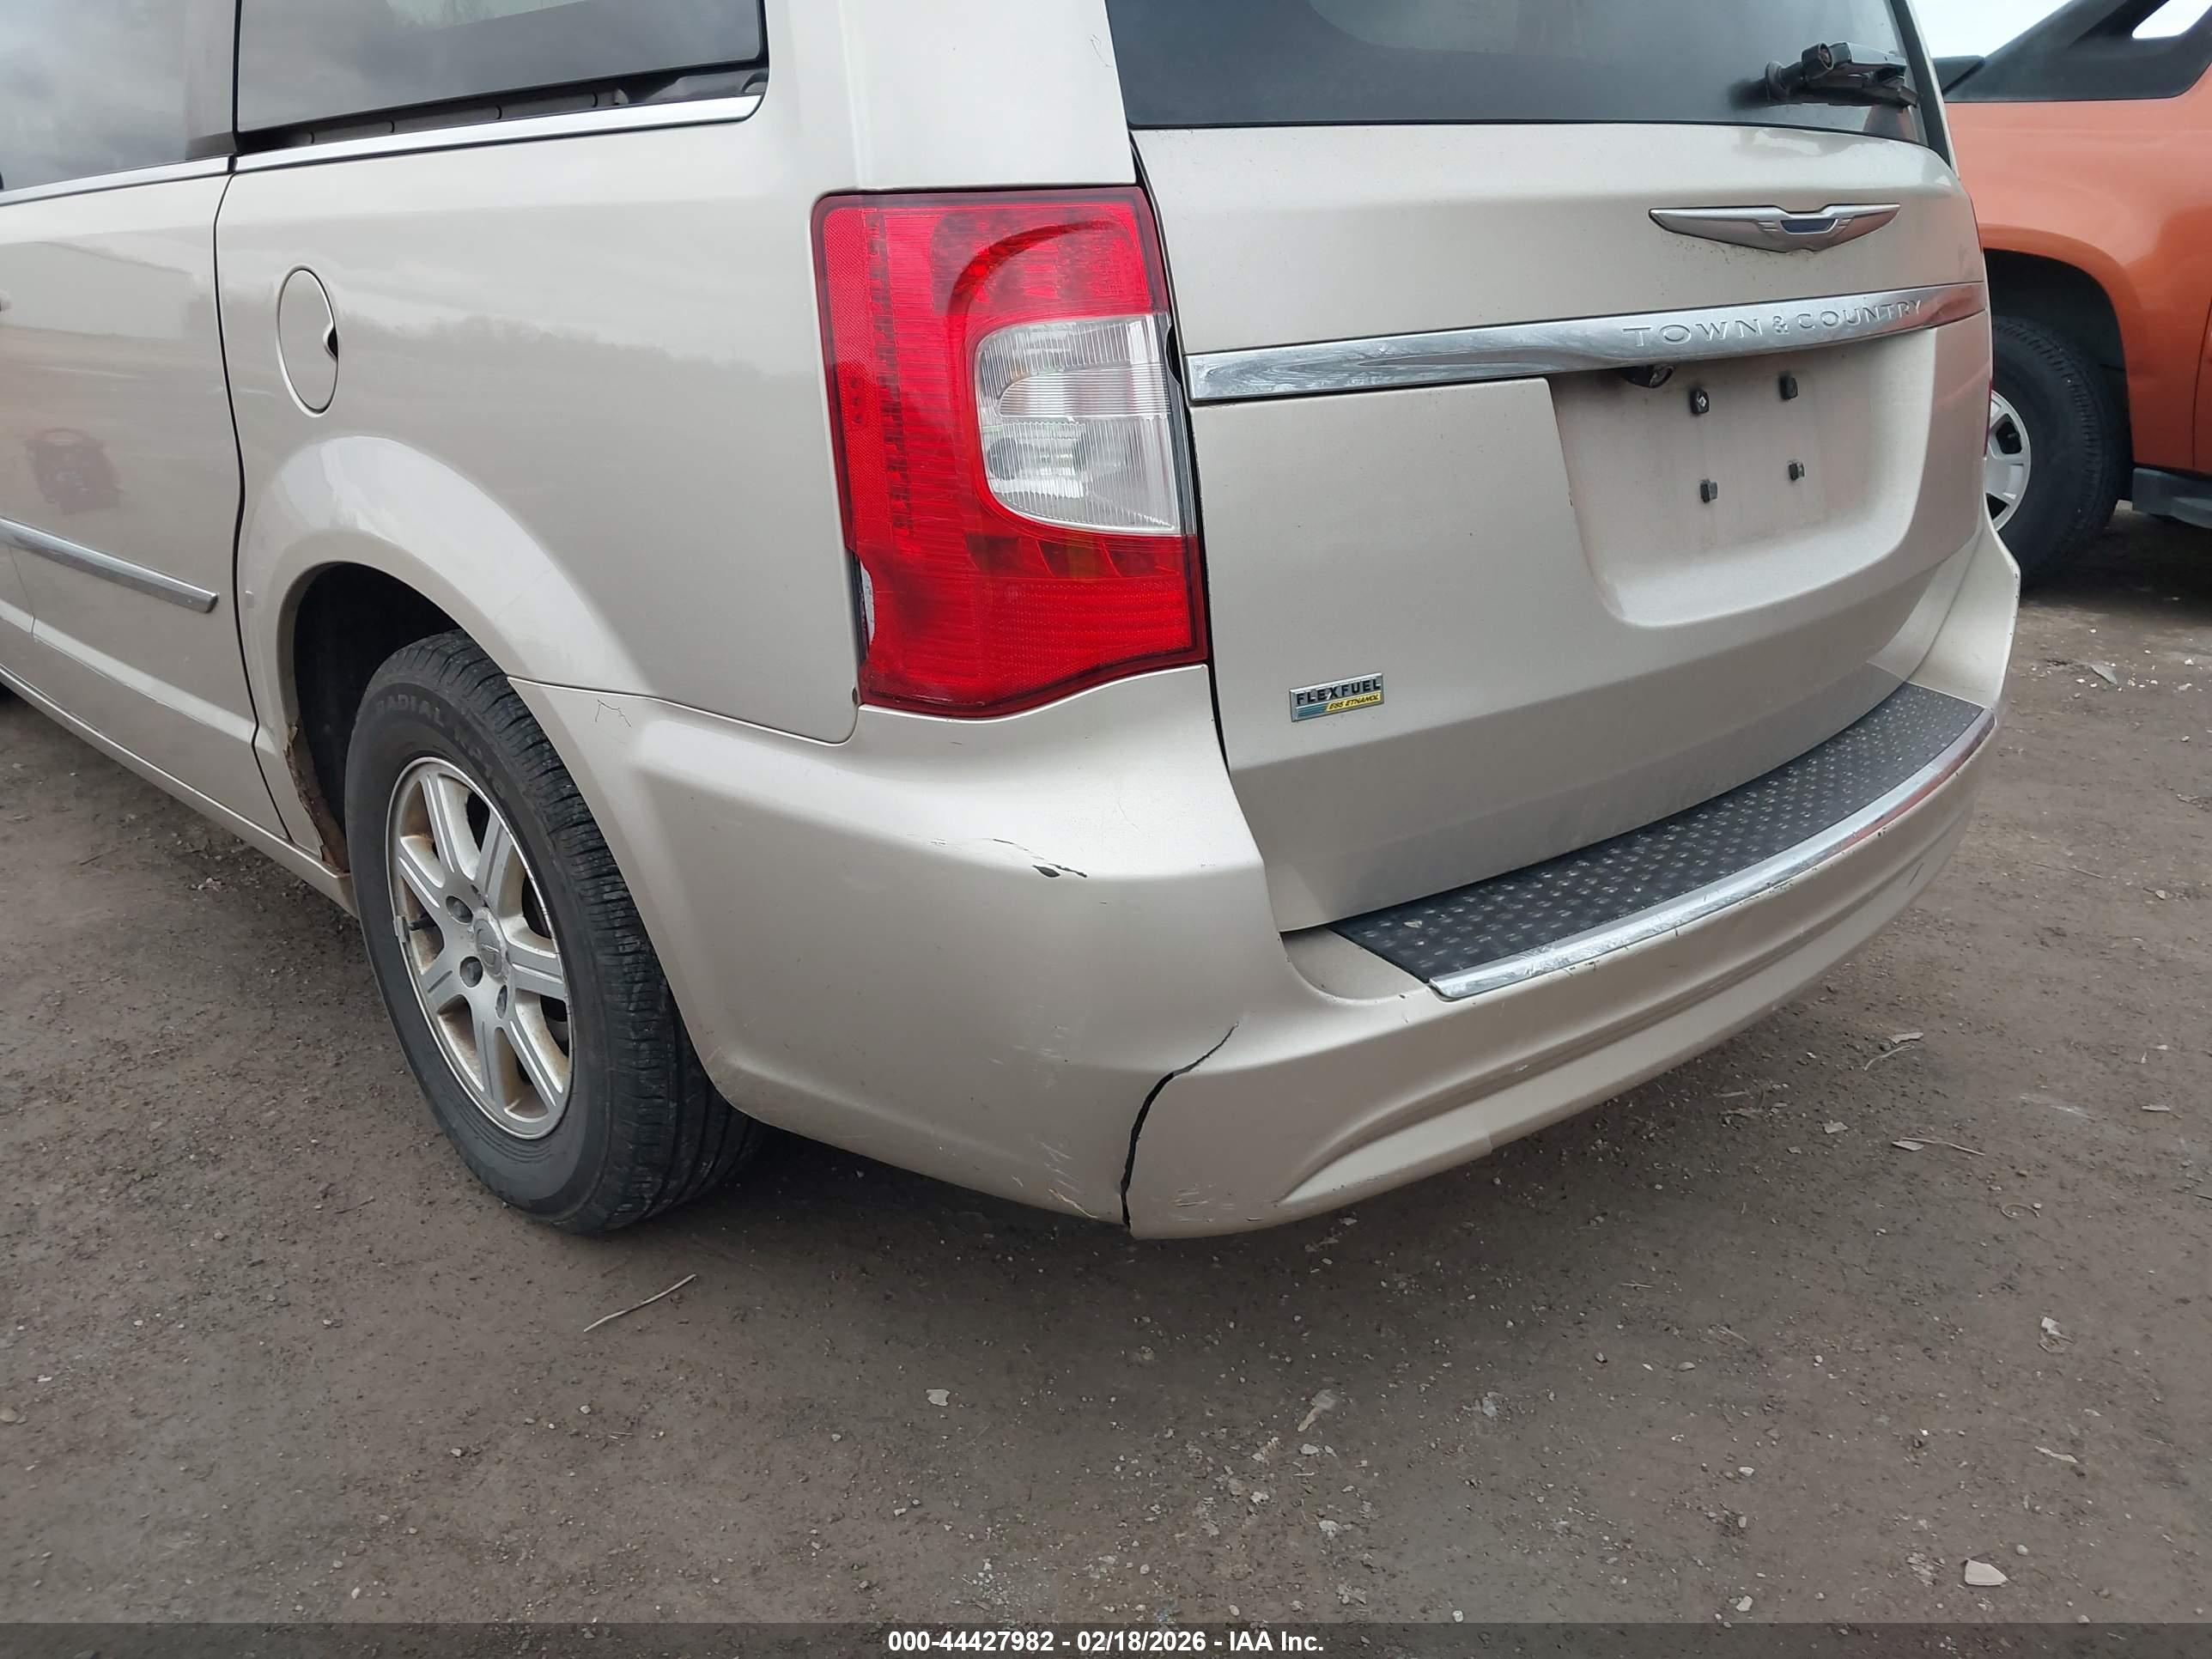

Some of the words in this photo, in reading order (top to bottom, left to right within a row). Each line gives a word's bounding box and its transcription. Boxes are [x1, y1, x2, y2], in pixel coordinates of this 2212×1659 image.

[1622, 319, 1763, 347] TOWN
[1796, 300, 1922, 330] COUNTRY
[1295, 678, 1382, 705] FLEXFUEL
